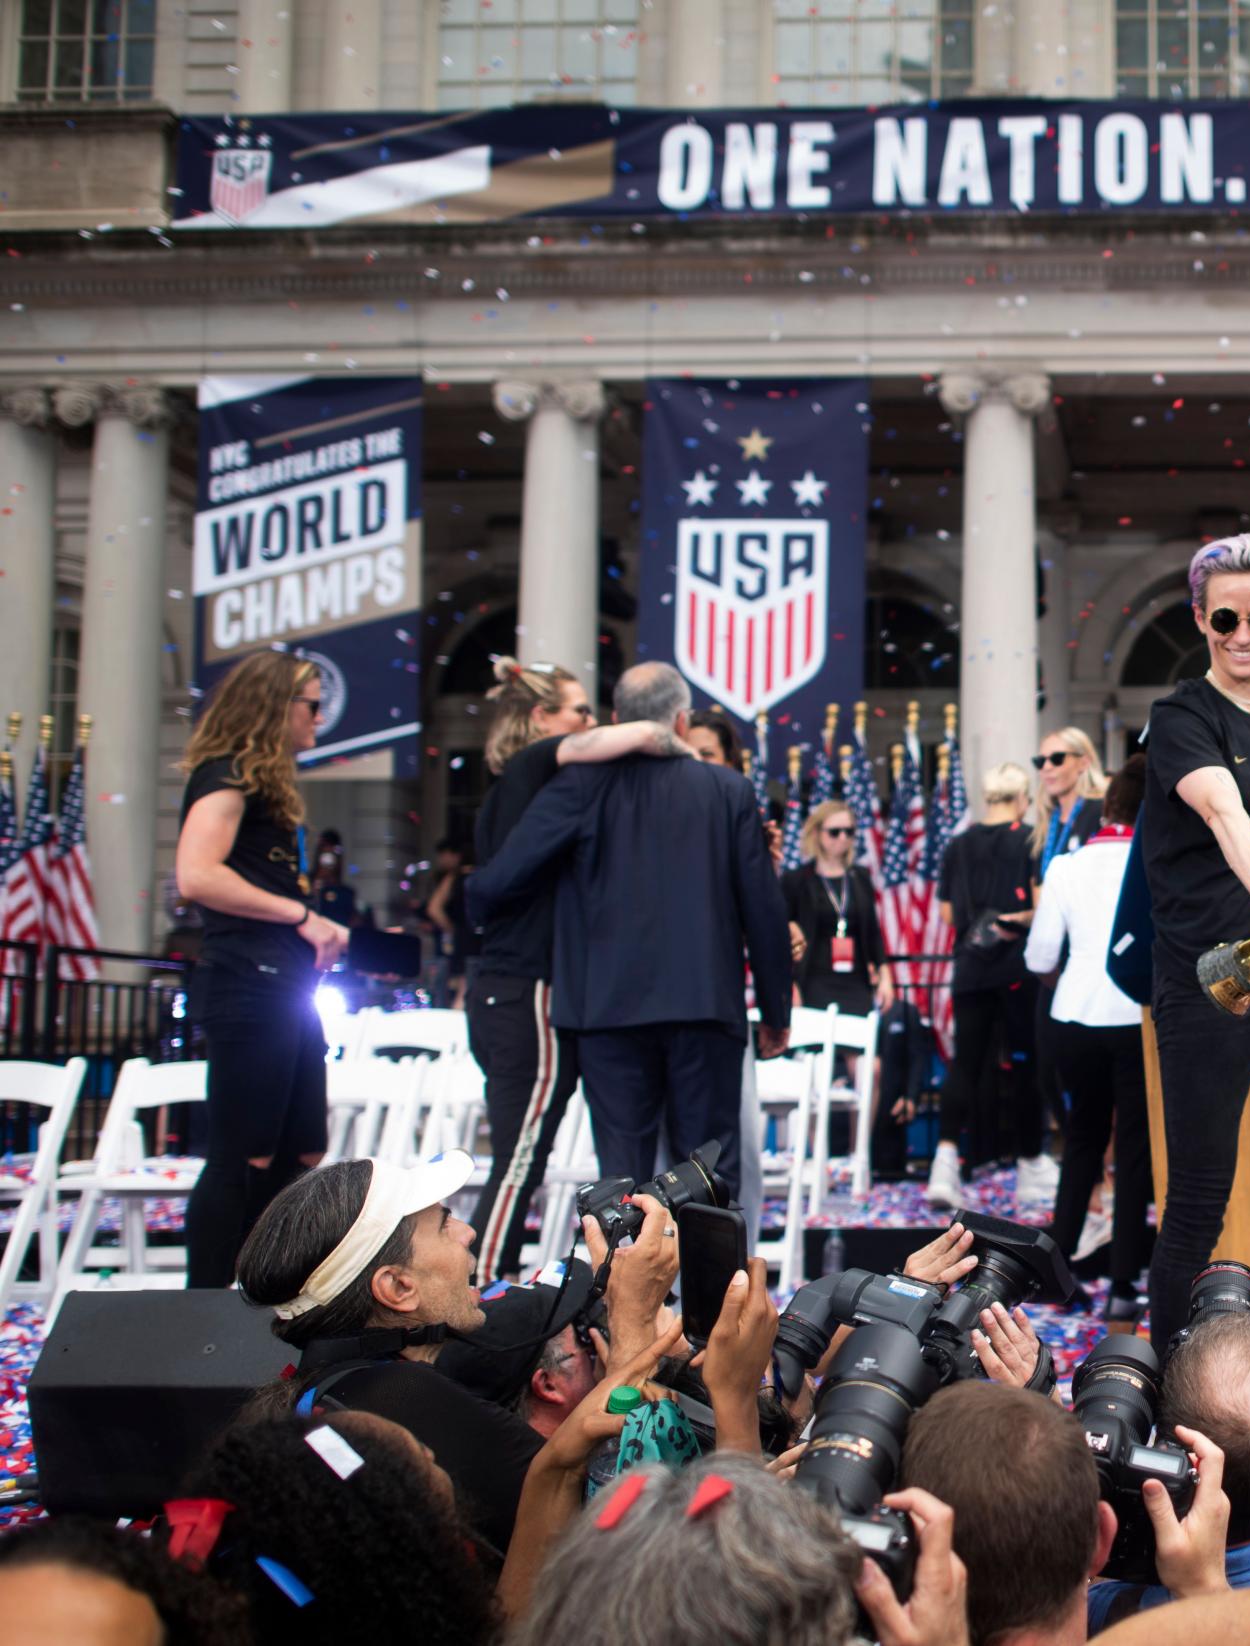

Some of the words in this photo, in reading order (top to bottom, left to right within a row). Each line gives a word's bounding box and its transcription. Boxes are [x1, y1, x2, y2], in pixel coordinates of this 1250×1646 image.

[217, 153, 264, 181] USA
[657, 121, 834, 211] ONE
[872, 112, 1246, 208] NATION.
[209, 440, 250, 474] NYC
[209, 436, 361, 502] CONGRATULATES
[364, 427, 403, 458] THE
[210, 479, 387, 576] WORLD
[213, 549, 405, 648] CHAMPS
[690, 532, 814, 602] USA
